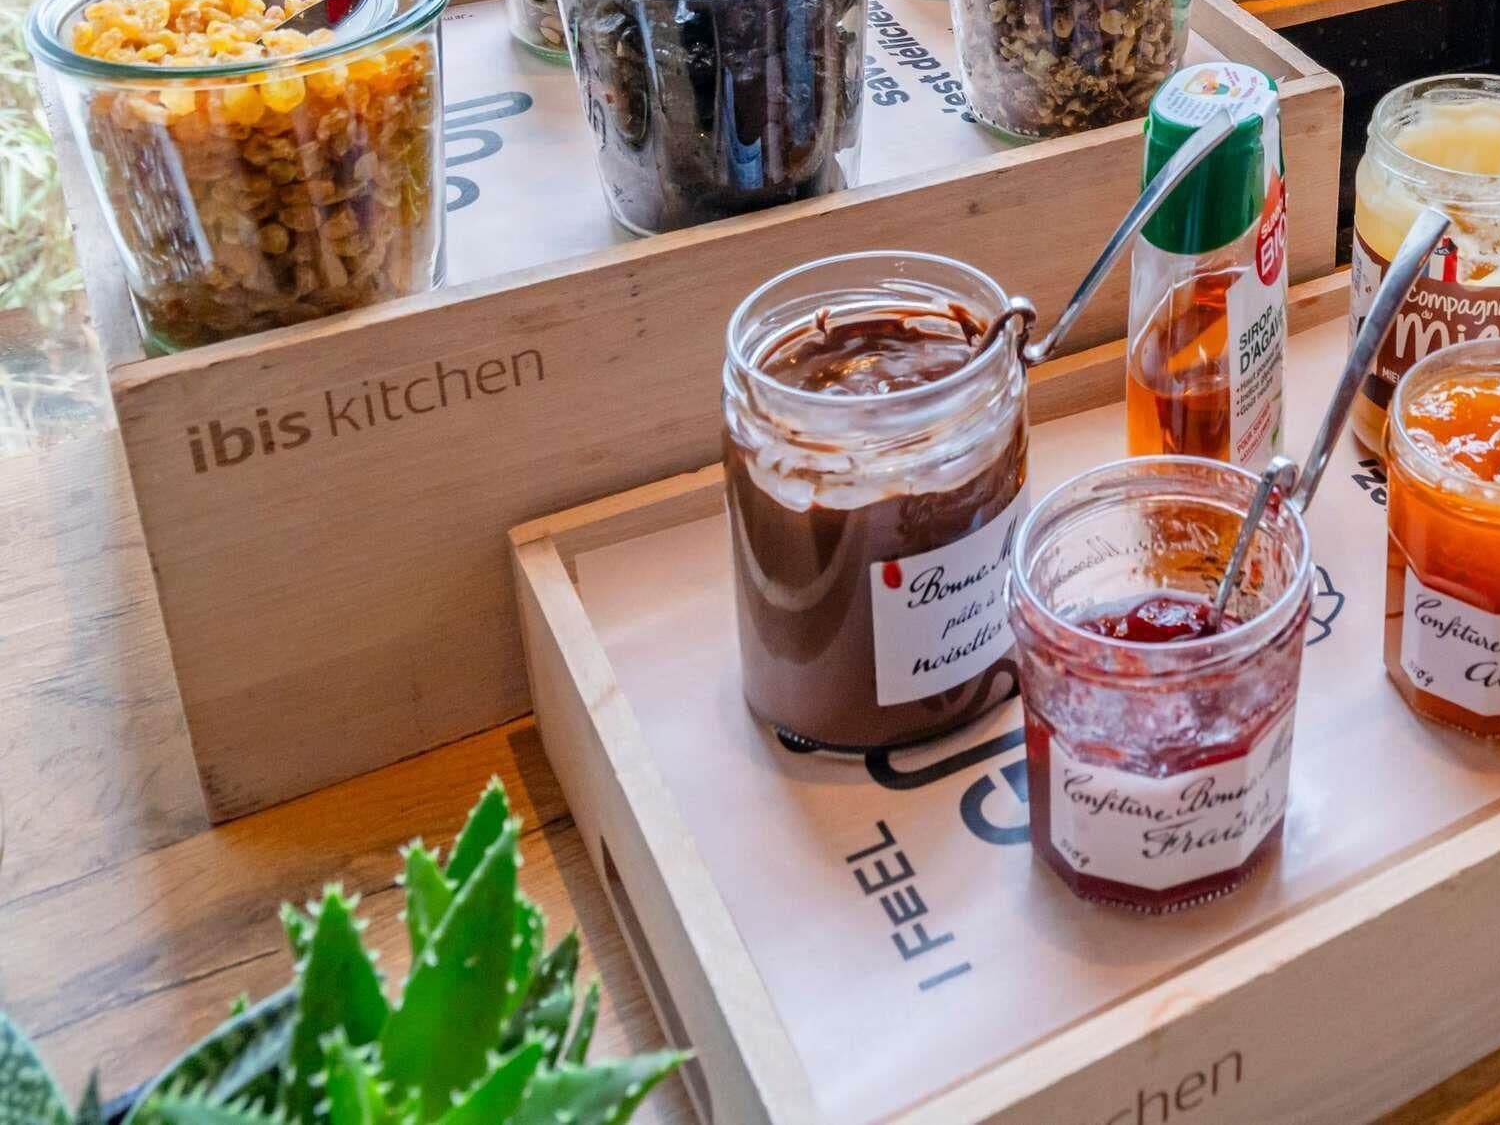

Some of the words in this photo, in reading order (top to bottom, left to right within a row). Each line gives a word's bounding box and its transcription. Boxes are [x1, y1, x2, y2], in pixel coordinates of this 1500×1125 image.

[1260, 213, 1288, 276] BIO
[1239, 305, 1273, 351] SIROP
[185, 406, 313, 475] ibis
[324, 348, 545, 437] kitchen
[906, 565, 989, 610] Bonne
[911, 617, 1002, 677] noisettes
[941, 598, 983, 641] pâte
[1063, 768, 1172, 823] Confiture
[845, 819, 956, 962] FEEL
